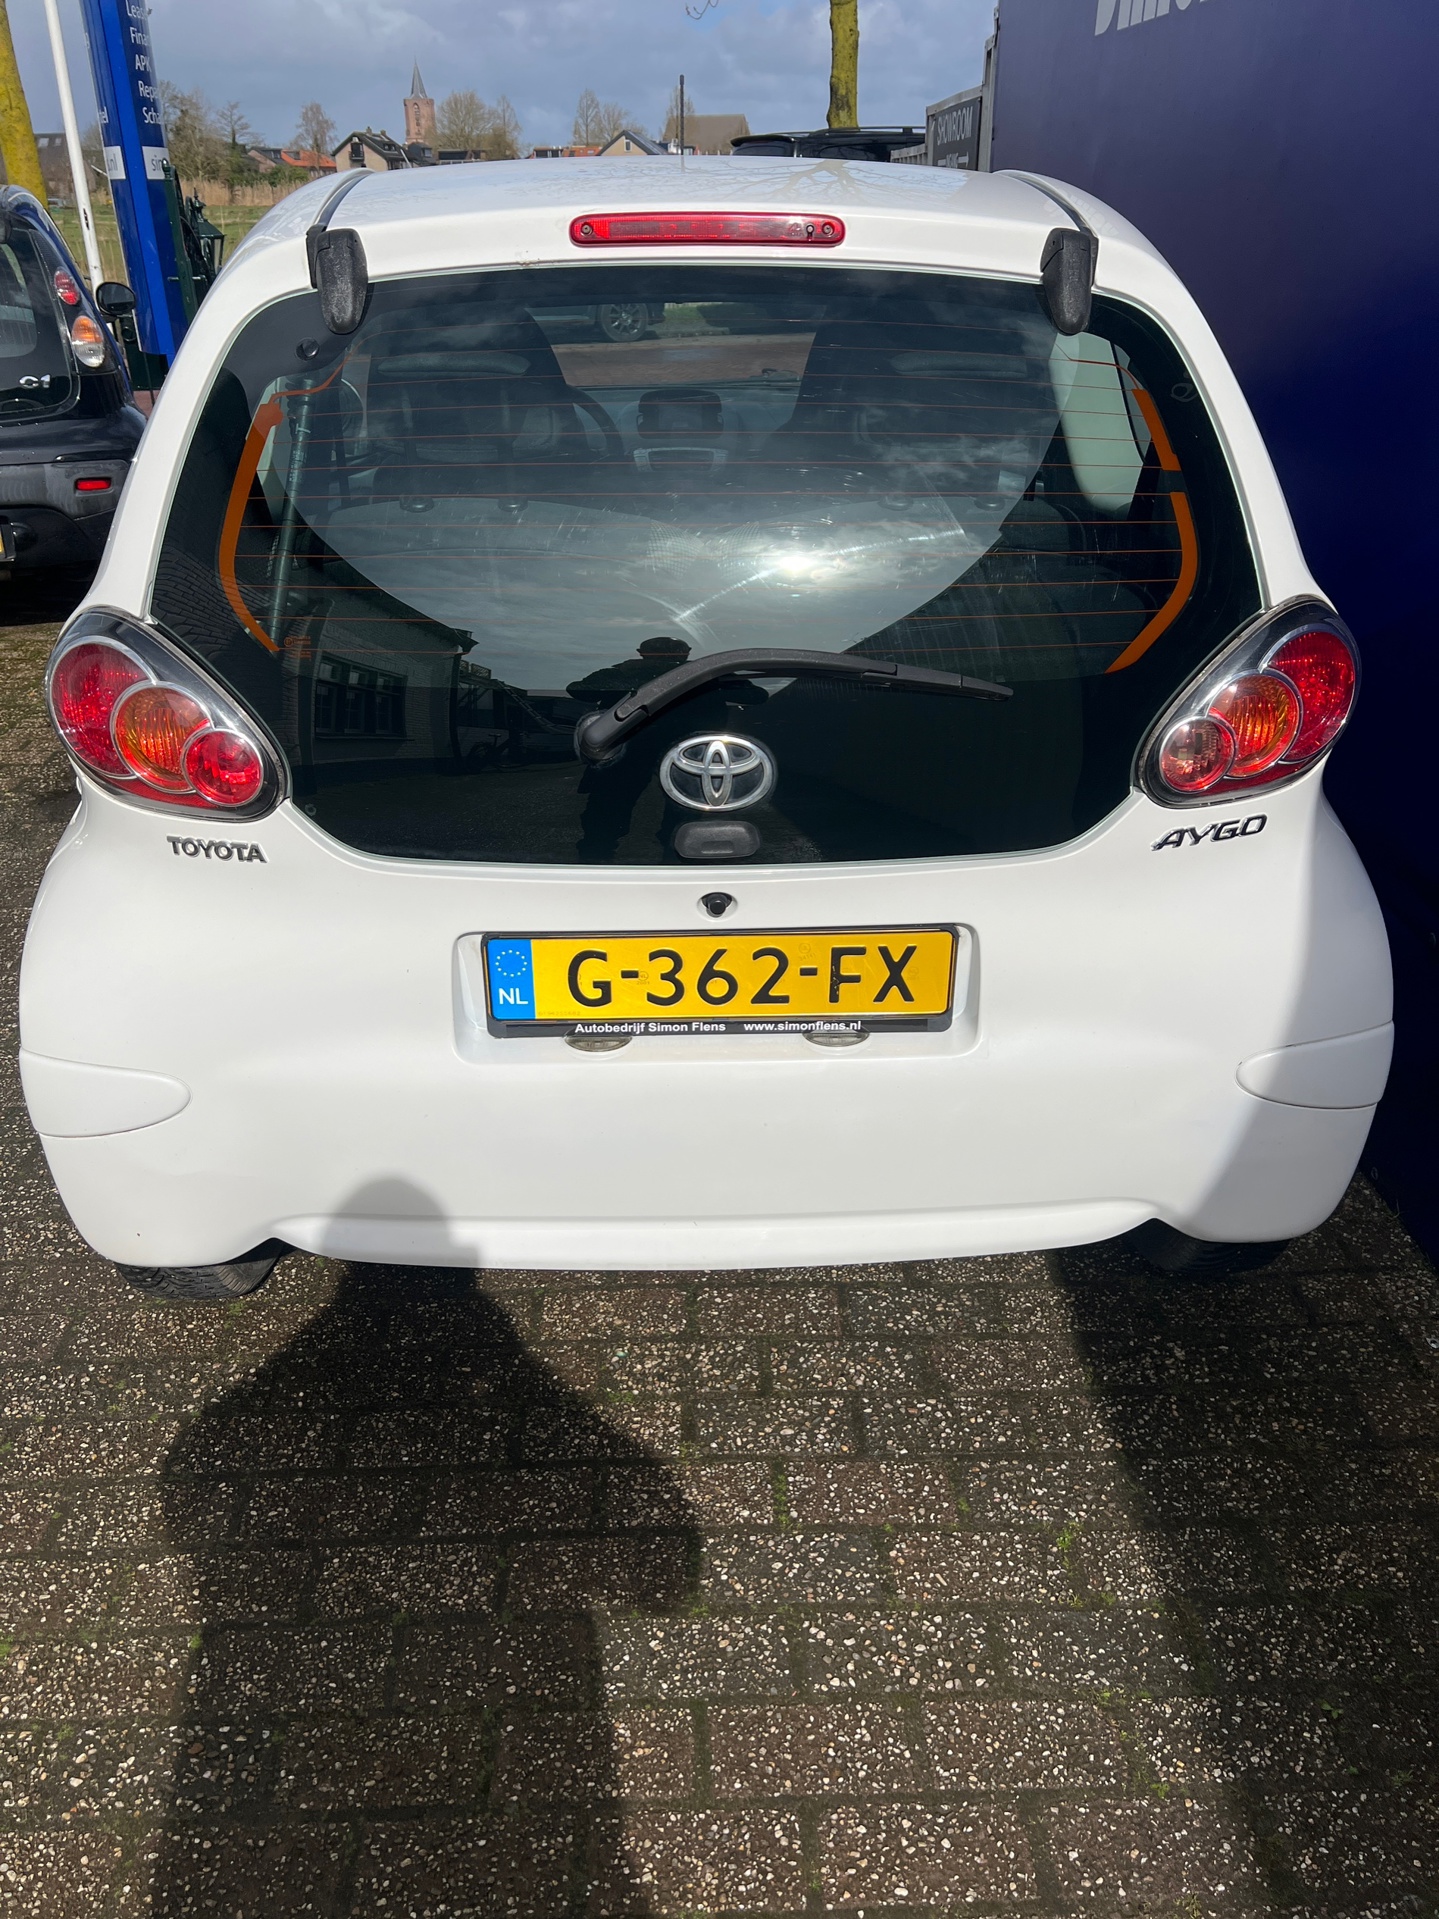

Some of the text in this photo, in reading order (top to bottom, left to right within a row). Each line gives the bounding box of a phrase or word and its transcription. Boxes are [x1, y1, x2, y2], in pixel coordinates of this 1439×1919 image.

[937, 106, 973, 146] SHOWROOM
[19, 374, 50, 389] C1
[1150, 813, 1268, 852] AYGO
[166, 835, 268, 863] TOYOTA
[567, 944, 917, 1008] G-362-FX
[498, 987, 529, 1005] NL
[574, 1020, 862, 1035] Autobedrijf Simon Flens www.simonflens.nl
